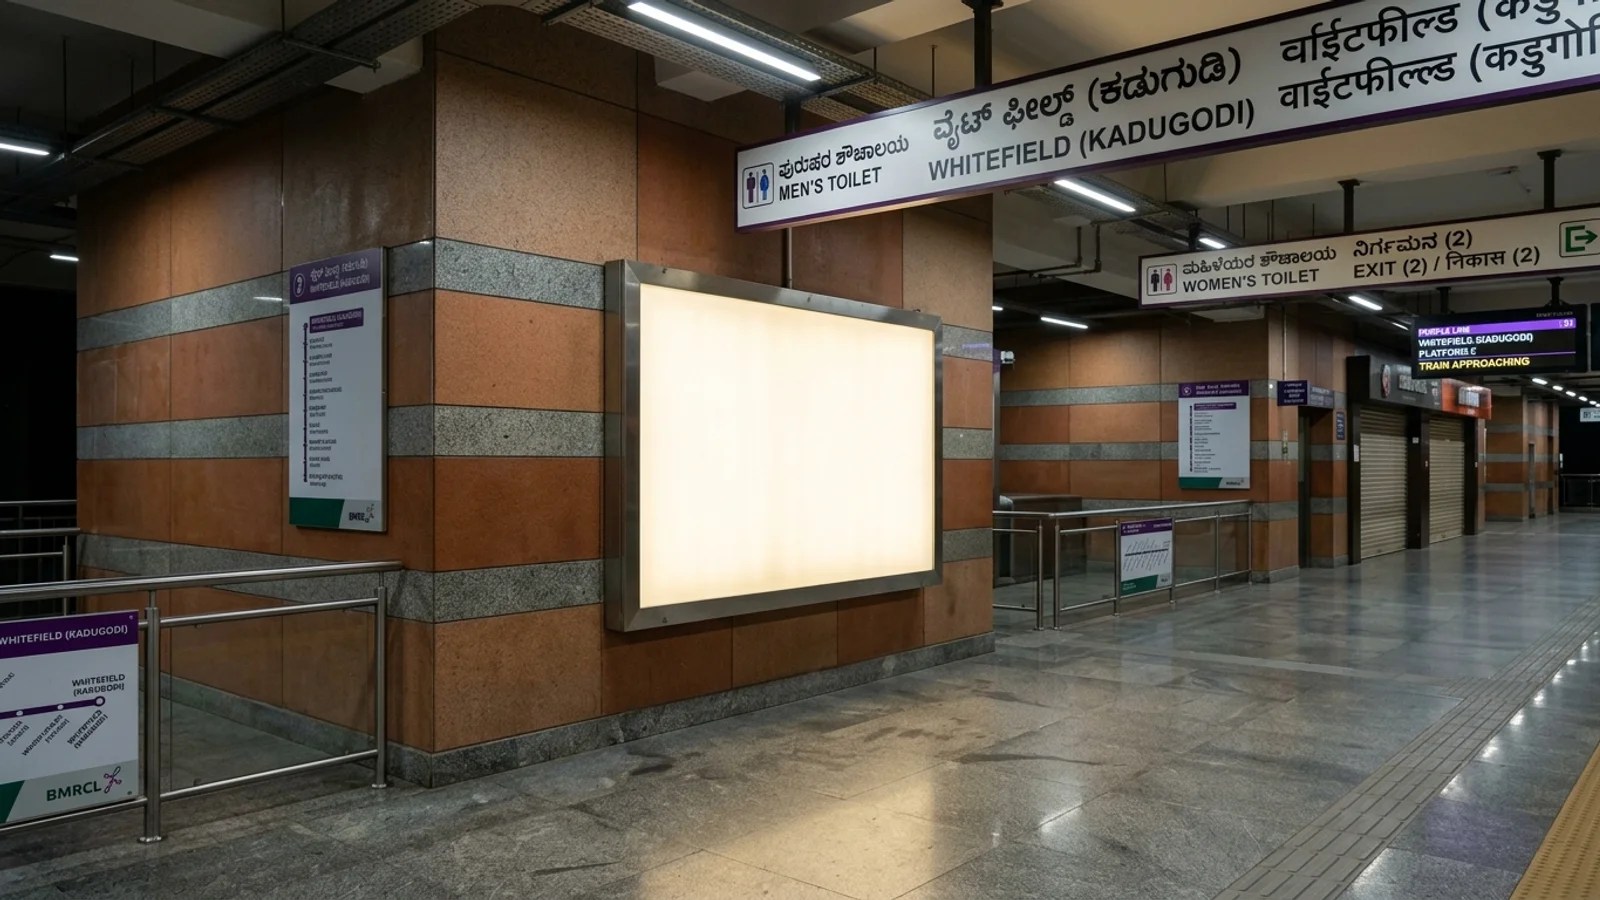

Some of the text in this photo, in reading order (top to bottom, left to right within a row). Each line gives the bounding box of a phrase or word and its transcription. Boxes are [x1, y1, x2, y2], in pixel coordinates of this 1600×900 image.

[928, 98, 1254, 181] WHITEFIELD (KADUGODI)
[779, 166, 882, 201] MEN'S TOILET
[1445, 229, 1473, 251] (2)
[1353, 261, 1396, 279] EXIT
[1403, 257, 1428, 278] (2)
[1433, 257, 1440, 271] /
[1513, 246, 1541, 267] (2)
[1183, 268, 1320, 293] WOMEN'S TOILET
[1419, 357, 1531, 371] TRAIN APPROACHING
[0, 624, 128, 645] WHITEFIELD (KADUGODI)
[46, 781, 102, 802] BMRCL
